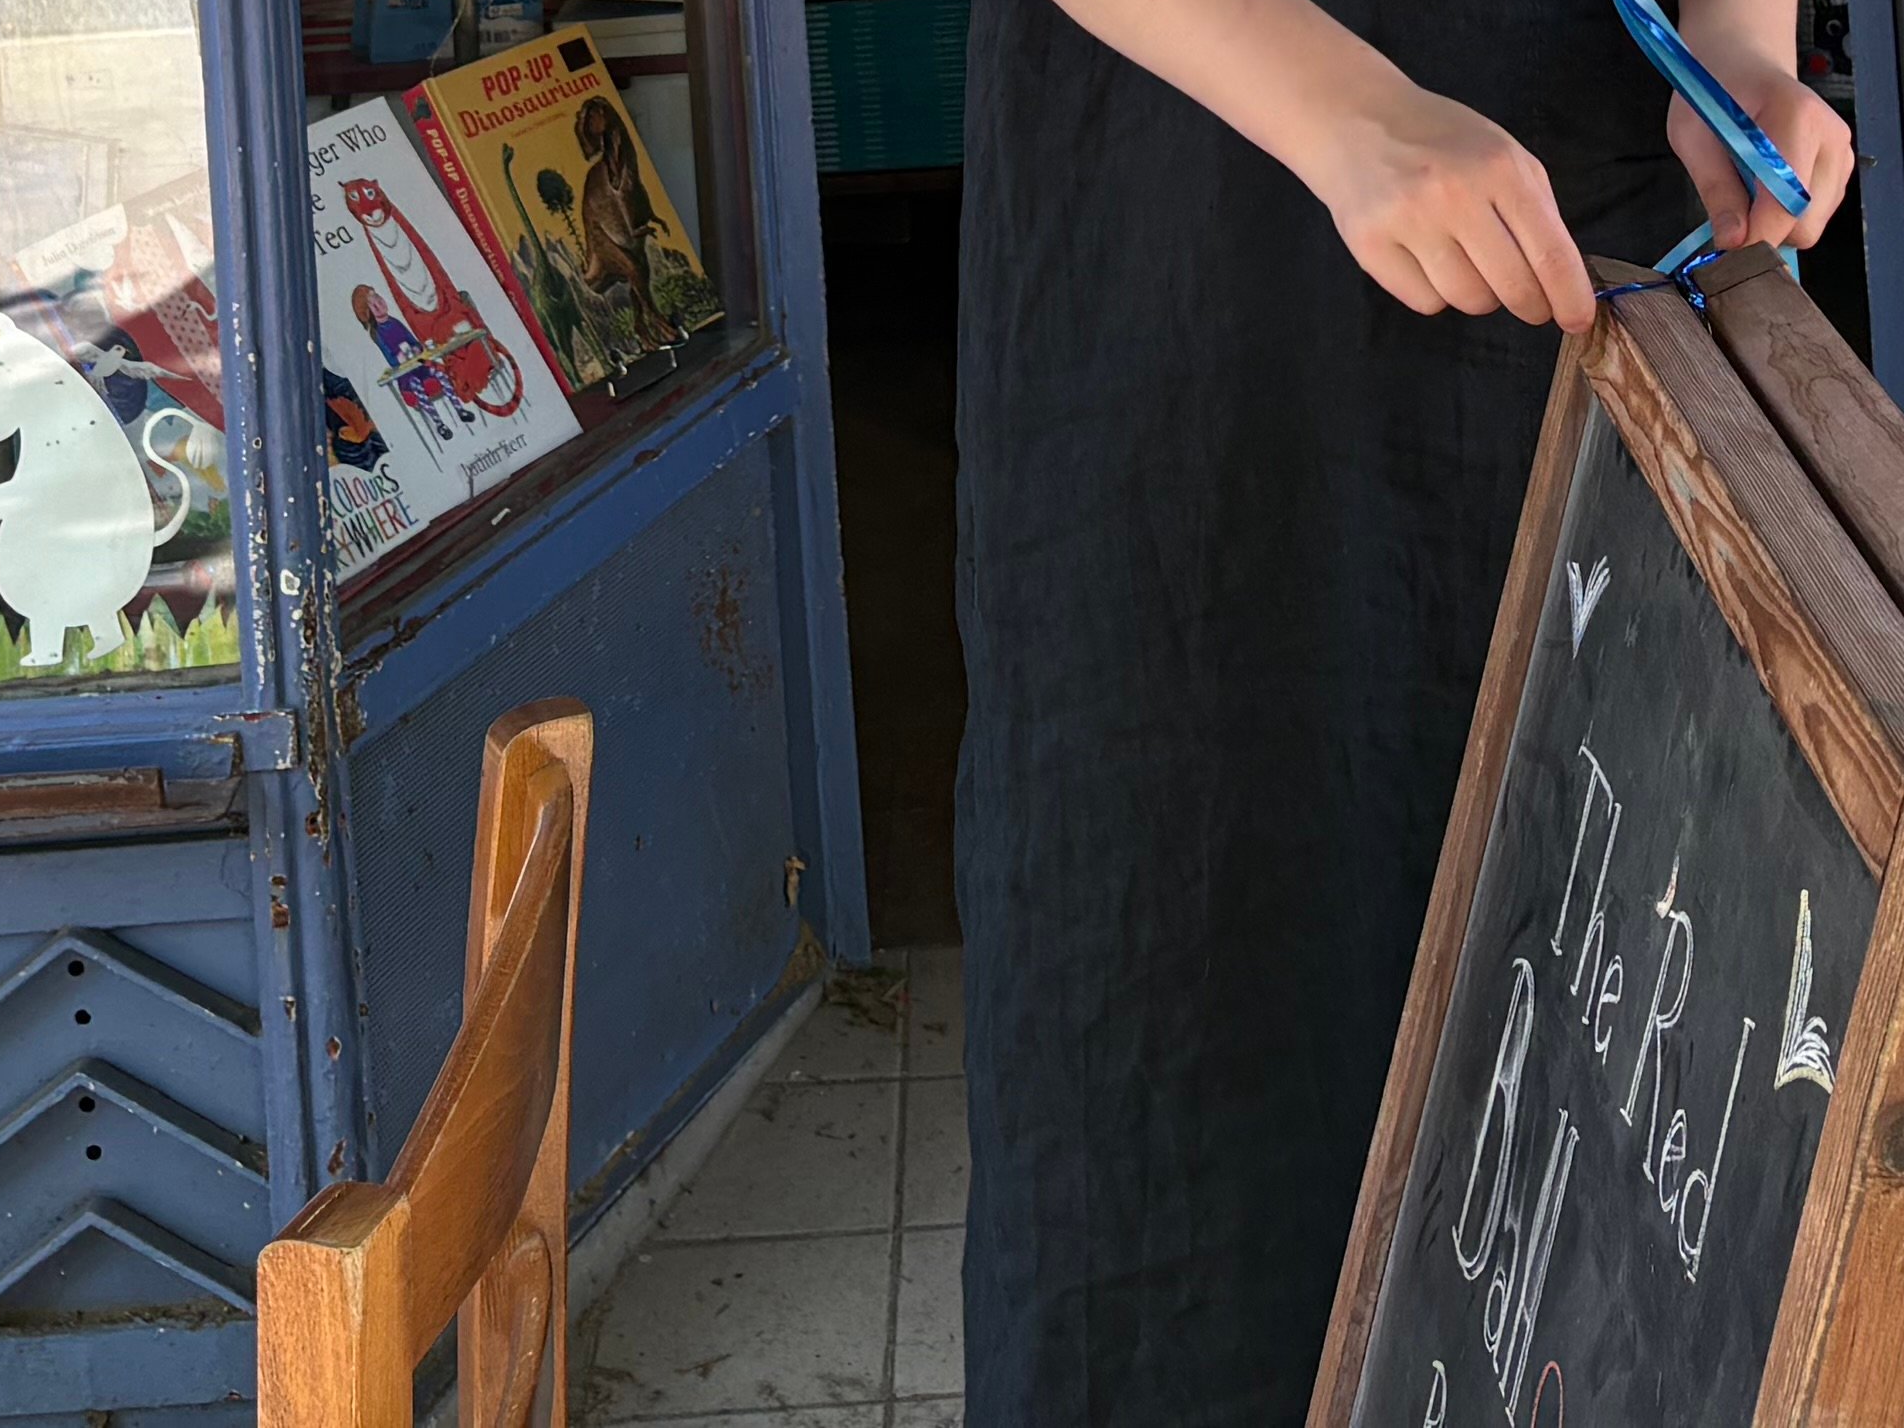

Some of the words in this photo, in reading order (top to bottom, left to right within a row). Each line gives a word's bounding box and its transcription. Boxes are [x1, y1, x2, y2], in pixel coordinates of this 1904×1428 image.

[481, 53, 555, 102] POP-UP
[457, 71, 601, 140] Dinosaurium
[310, 141, 340, 177] ger
[337, 122, 387, 155] Who
[426, 128, 460, 183] POP-UP
[1620, 911, 1756, 1284] Red
